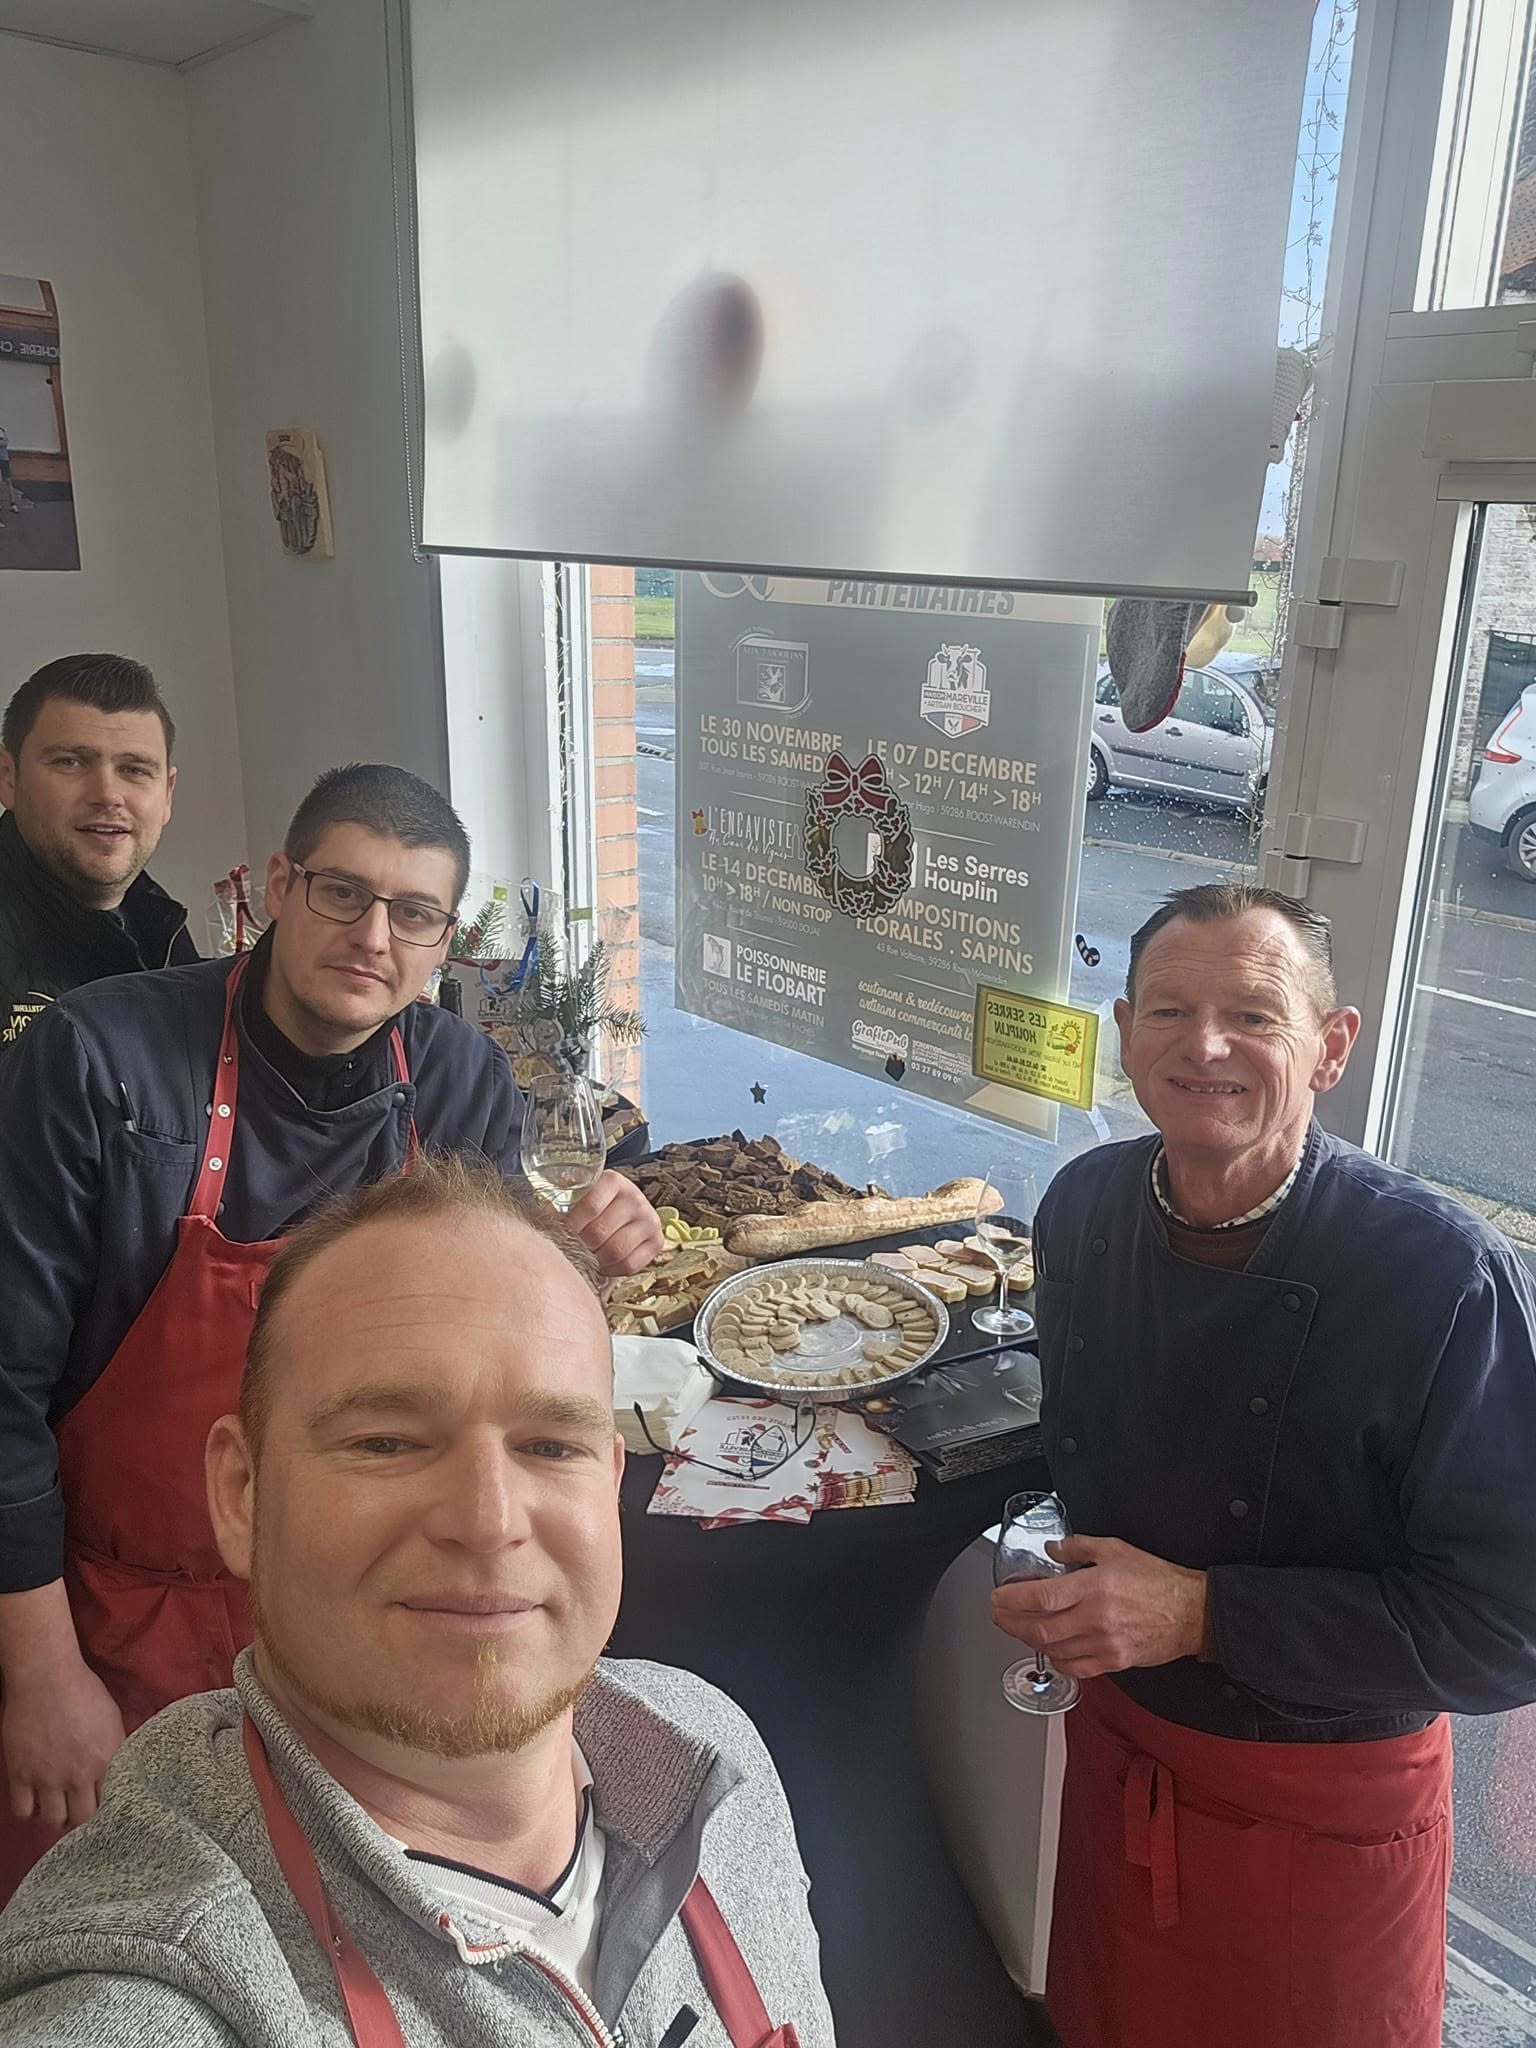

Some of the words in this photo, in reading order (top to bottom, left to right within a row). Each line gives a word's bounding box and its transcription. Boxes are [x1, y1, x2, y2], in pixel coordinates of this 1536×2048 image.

[827, 579, 1015, 616] PARTENAIRES
[946, 692, 988, 706] MAREVILLE
[700, 714, 717, 733] LE
[722, 717, 741, 738] 30
[747, 721, 842, 752] NOVEMBRE
[700, 737, 738, 758] TOUS
[743, 743, 766, 763] LES
[770, 748, 826, 773] SAMED
[893, 743, 918, 766] 07
[924, 748, 1037, 785] DECEMBRE
[708, 805, 792, 849] L'ENCAVISTE
[941, 804, 964, 818] 59286
[723, 856, 741, 878] 14
[745, 862, 823, 898] DECEMBR
[924, 868, 998, 904] Houplin
[925, 847, 959, 872] Les
[964, 855, 1029, 888] Serres
[772, 895, 801, 916] NON
[802, 904, 832, 924] STOP
[886, 898, 1021, 945] MPOSITIONS
[736, 944, 827, 985] POISSONNERIE
[856, 916, 943, 952] FLORALES
[961, 938, 1033, 975] SAPINS
[928, 955, 951, 971] 59286
[703, 978, 728, 995] TOUS
[730, 986, 745, 1001] LES
[747, 993, 790, 1016] SAMEDIS
[791, 1007, 825, 1027] MATIN
[736, 961, 752, 984] LE
[757, 967, 826, 1007] FLOBART
[906, 992, 916, 1007] &
